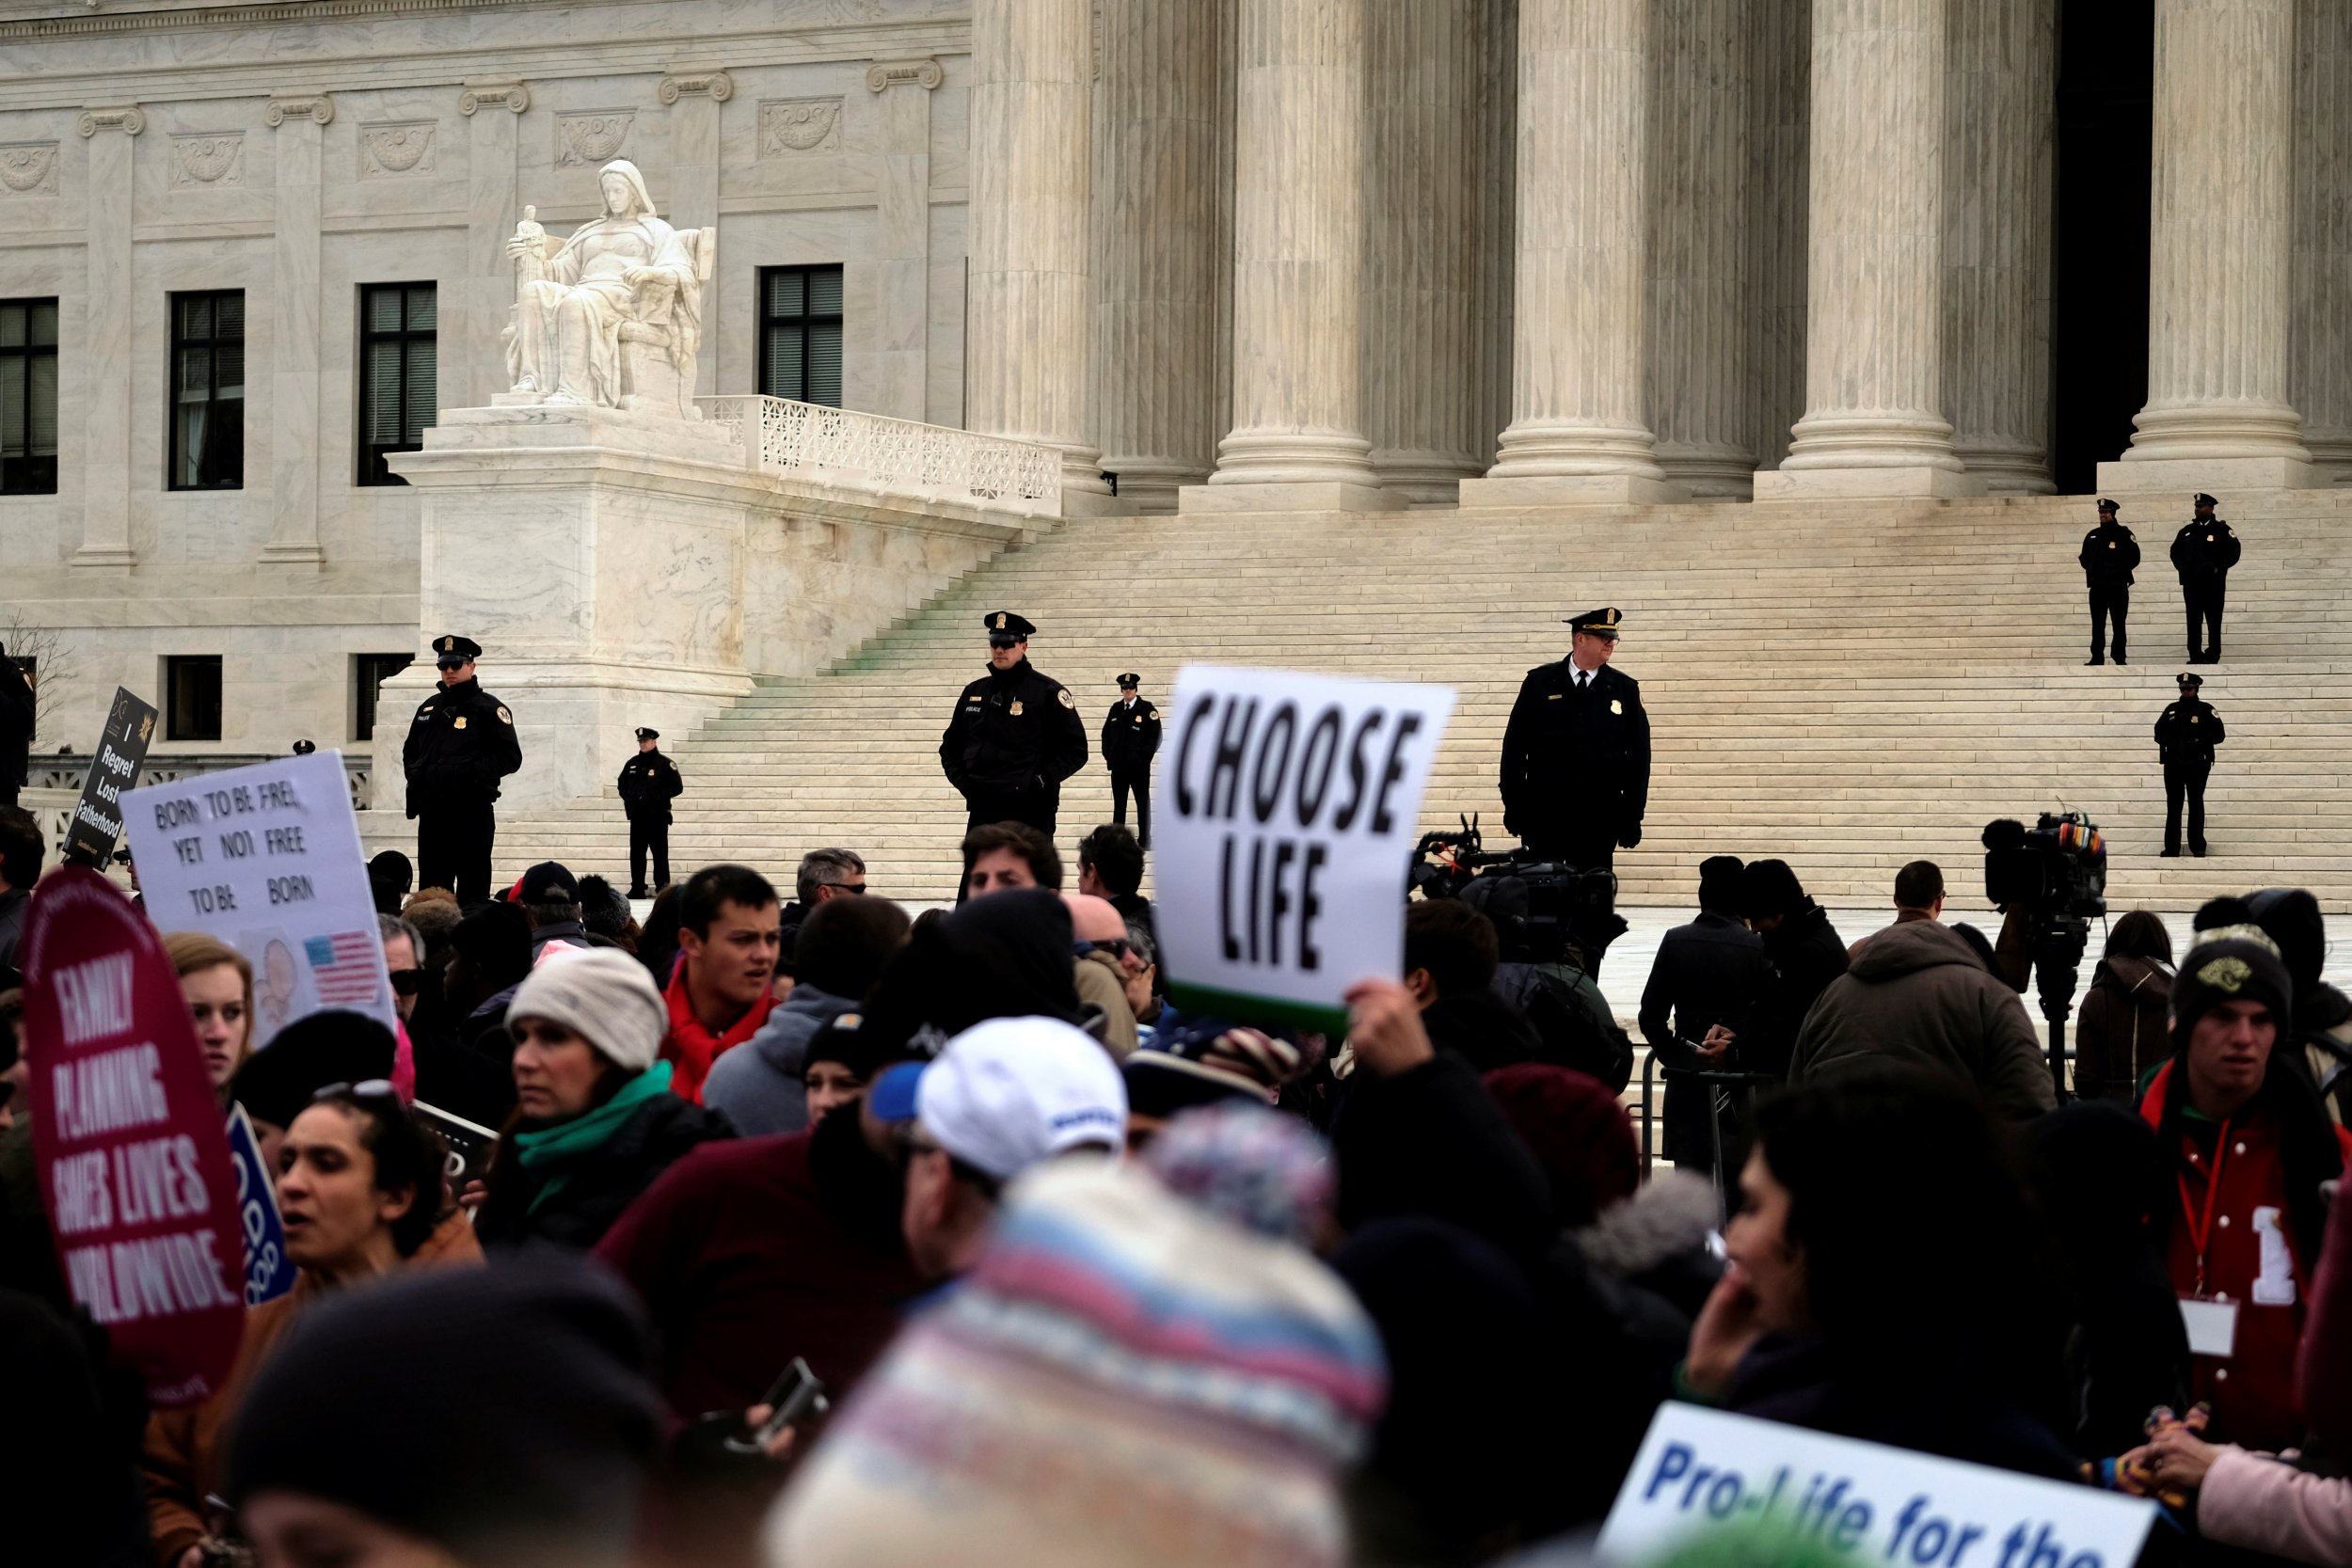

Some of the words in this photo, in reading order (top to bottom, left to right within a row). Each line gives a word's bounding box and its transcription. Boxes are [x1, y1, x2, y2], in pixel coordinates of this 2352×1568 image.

[123, 722, 133, 742] I
[101, 743, 135, 779] Regret
[1173, 689, 1423, 835] CHOOSE
[96, 775, 119, 804] Lost
[154, 797, 199, 831] BORN
[204, 790, 231, 818] TO
[232, 784, 255, 813] BE
[75, 799, 122, 839] Fatherhood
[173, 836, 203, 865] YET
[219, 830, 255, 860] NOT
[264, 826, 306, 856] FREE
[189, 888, 215, 915] TO
[215, 884, 237, 911] BE
[266, 875, 314, 906] BORN
[1220, 834, 1327, 972] LIFE
[54, 949, 135, 1047] FAMILY
[54, 1041, 170, 1143] PLANNING
[53, 1148, 113, 1235] SAVES
[114, 1133, 211, 1226] LIVES
[1883, 1493, 1987, 1568] for
